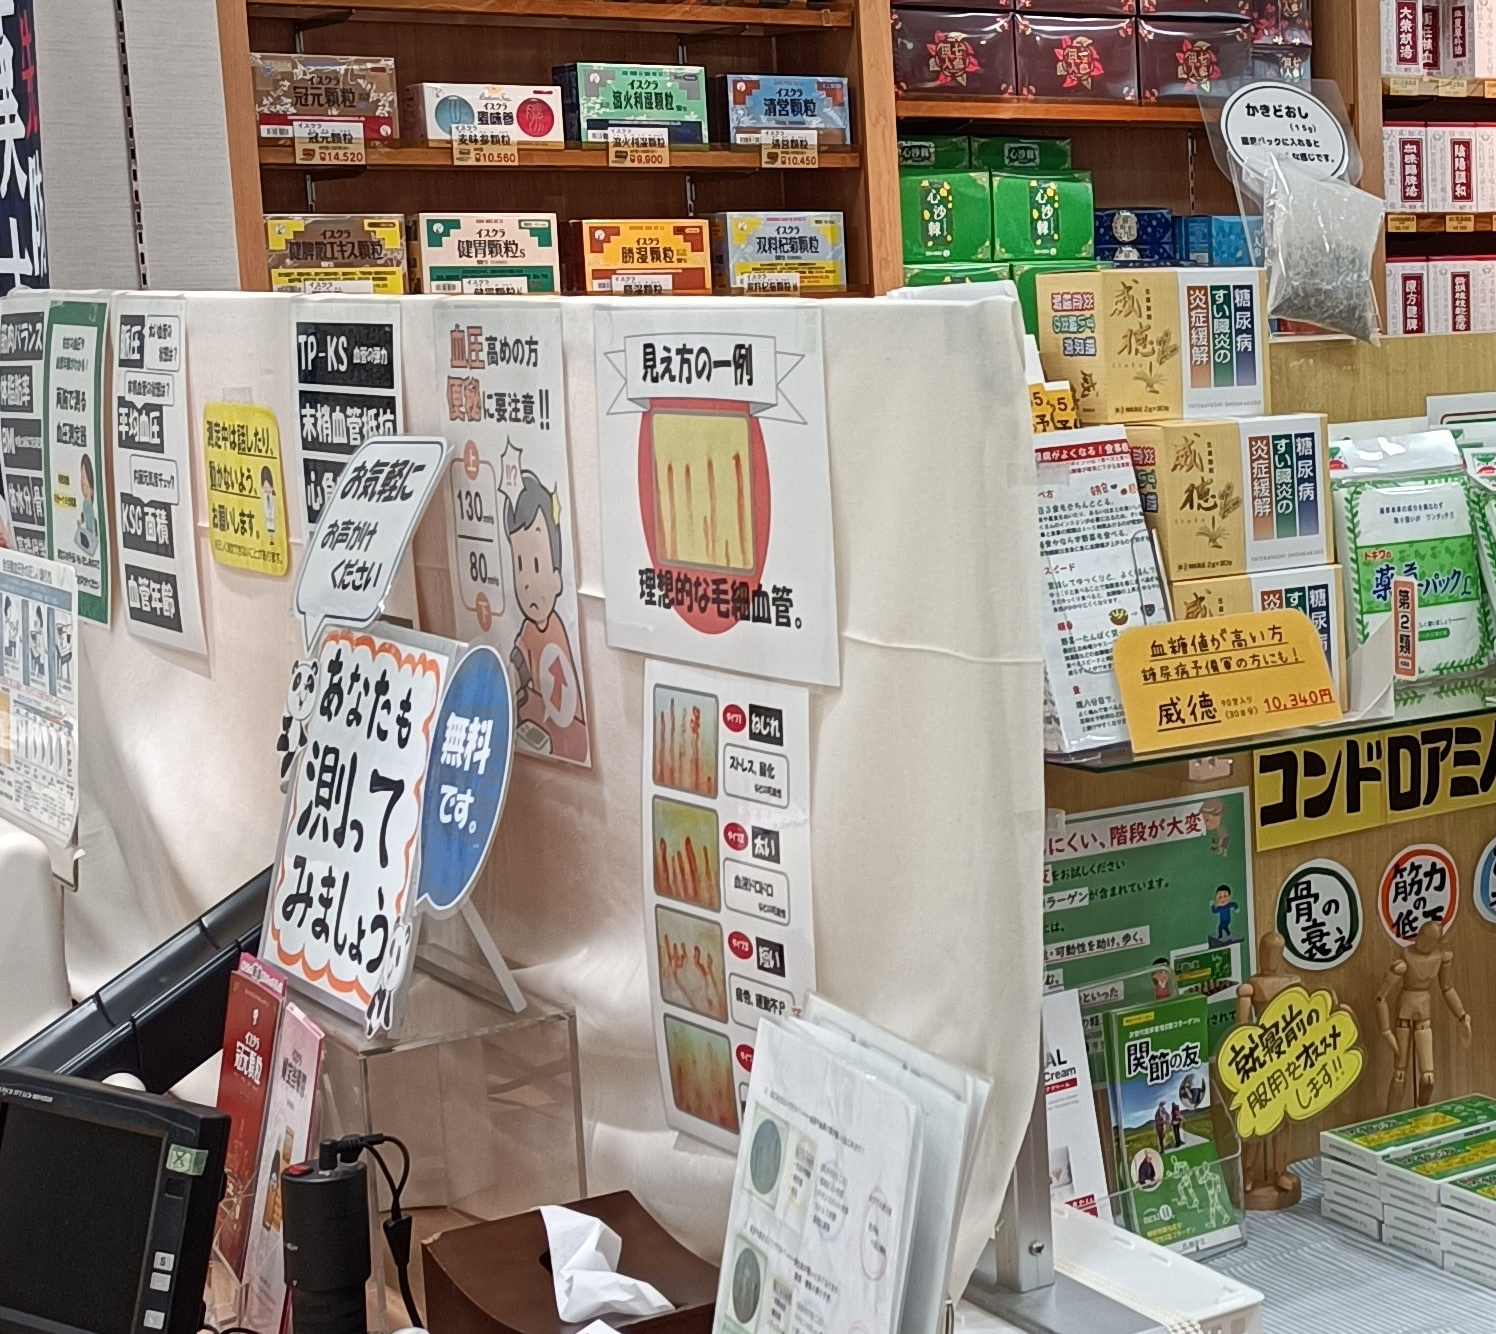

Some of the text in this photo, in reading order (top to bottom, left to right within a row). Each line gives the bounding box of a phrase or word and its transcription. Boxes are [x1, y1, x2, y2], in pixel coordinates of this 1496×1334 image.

[1400, 7, 1413, 59] 大柴胡湯
[307, 75, 341, 86] イスクラ
[628, 80, 659, 90] イスクラ
[775, 88, 803, 97] イスクラ
[1245, 103, 1309, 119] かきどおし
[319, 228, 351, 239] イスクラ
[475, 228, 505, 238] イスクラ
[635, 237, 660, 247] イスクラ
[775, 225, 800, 235] イスクラ
[1188, 288, 1210, 366] 炎症緩解
[1212, 288, 1232, 365] すい臓炎の
[1233, 286, 1254, 353] 糖尿病
[297, 334, 348, 371] TP-KS
[450, 324, 539, 370] 血圧高めの方
[640, 343, 755, 386] 見え方の一例
[340, 459, 426, 503] お気軽に
[1251, 439, 1272, 518] 炎症緩解
[1274, 437, 1294, 515] すい臓炎の
[1295, 435, 1315, 502] 糖尿病
[211, 503, 260, 539] お願いします。
[457, 489, 484, 523] 130
[320, 519, 378, 552] お声がけ
[330, 559, 383, 592] ください
[470, 551, 489, 584] 80
[637, 568, 804, 630] 理想的な毛細血管。
[1149, 624, 1285, 659] 血糖値が高い方
[1398, 589, 1411, 657] 第2類
[1141, 646, 1302, 683] 糖尿病予備軍の方にも!
[318, 648, 413, 750] あなたも
[1157, 691, 1220, 727] 威徳
[1263, 687, 1335, 714] 10,340円
[440, 711, 495, 776] 無料
[750, 712, 782, 740] ねじれ
[296, 739, 406, 869] 測って
[437, 783, 478, 835] です。
[752, 834, 777, 859] 太い
[1285, 880, 1340, 925] 骨の
[1392, 862, 1447, 904] 筋力
[281, 854, 389, 974] みましょう
[1413, 896, 1427, 911] の
[1300, 924, 1354, 960] 衰え
[1126, 1039, 1200, 1082] 関節の友
[1228, 1003, 1320, 1085] 就寝前の
[1295, 1055, 1346, 1110] します!!
